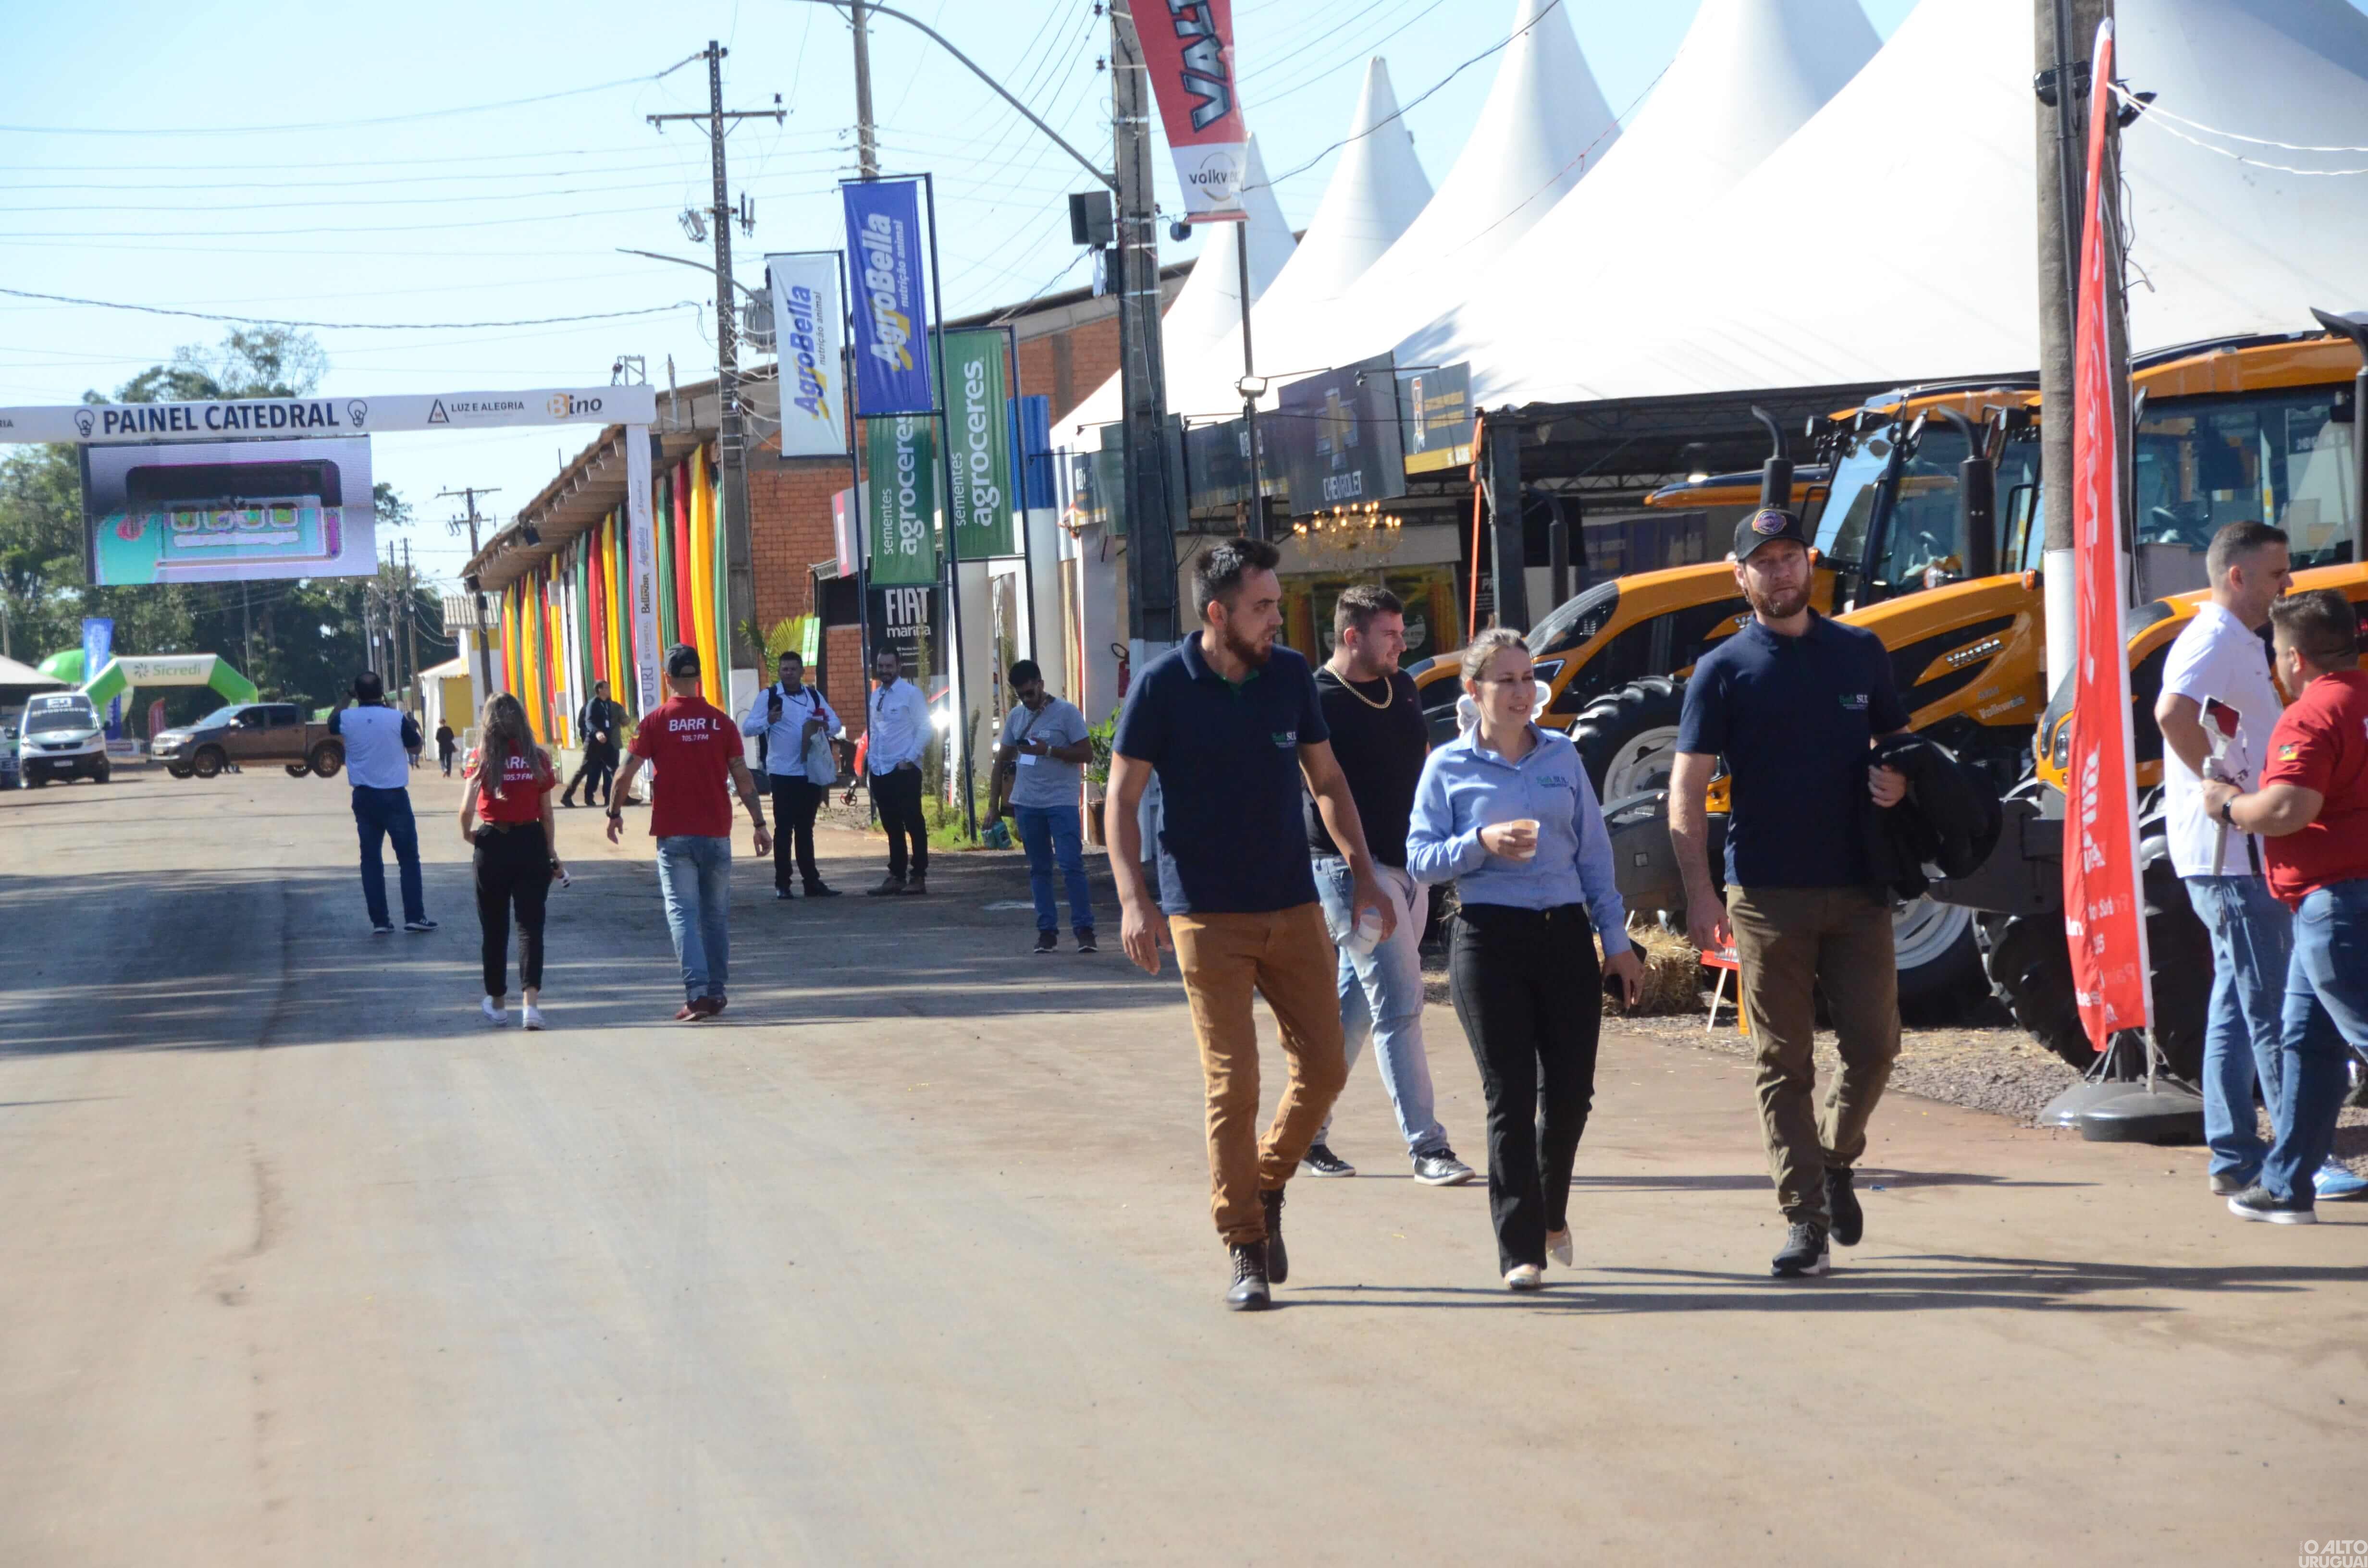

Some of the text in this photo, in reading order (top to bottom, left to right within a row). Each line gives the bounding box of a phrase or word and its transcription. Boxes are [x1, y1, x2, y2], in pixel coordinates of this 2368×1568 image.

[894, 220, 905, 258] animal
[861, 213, 912, 373] AgroBella
[788, 284, 829, 422] AgroBella
[103, 403, 340, 435] PAINEL CATEDRAL
[451, 404, 469, 412] LUZ
[481, 402, 525, 411] ALEGRIA
[546, 393, 602, 419] Bino
[963, 360, 1000, 527] agroceres
[895, 412, 925, 556] agroceres
[955, 453, 966, 527] sementes
[1323, 471, 1362, 501] CHEVROLET
[880, 488, 894, 555] sementes
[885, 588, 929, 625] FIAT
[887, 625, 931, 638] marina
[1947, 638, 2003, 668] VALTRA
[153, 663, 200, 676] Sicredi
[643, 667, 654, 692] URI
[668, 718, 721, 732] BARRL
